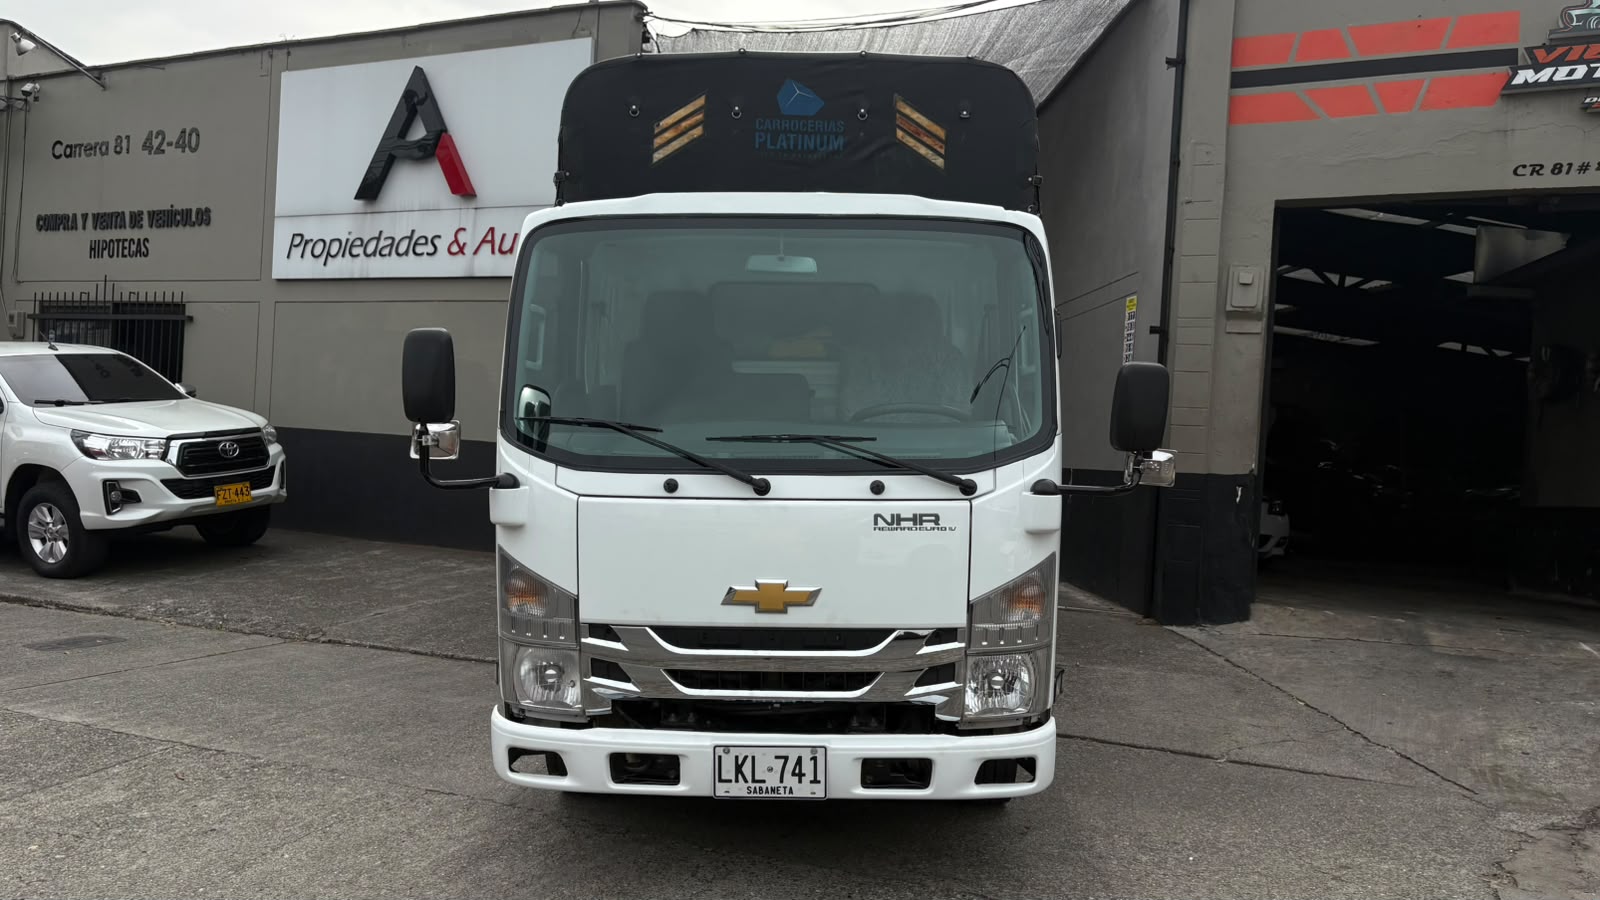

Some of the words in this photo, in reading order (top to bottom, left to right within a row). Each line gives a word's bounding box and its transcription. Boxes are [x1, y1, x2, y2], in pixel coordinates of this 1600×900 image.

[755, 118, 845, 133] CARROCERIAS
[51, 140, 110, 160] Carrera
[113, 134, 131, 155] 81
[141, 126, 201, 155] 42-40
[754, 132, 845, 152] PLATINUM
[1512, 163, 1545, 177] CR
[35, 213, 79, 232] COMPRA
[80, 212, 89, 231] Y
[91, 210, 128, 231] VENTA
[128, 210, 144, 229] DE
[88, 237, 150, 260] HIPOTECAS
[286, 229, 442, 267] Propiedades
[447, 227, 467, 257] &
[216, 488, 232, 500] FZT
[873, 513, 941, 526] NHR
[717, 754, 767, 784] LKL
[774, 755, 821, 784] 741
[746, 785, 794, 796] SABANETA
